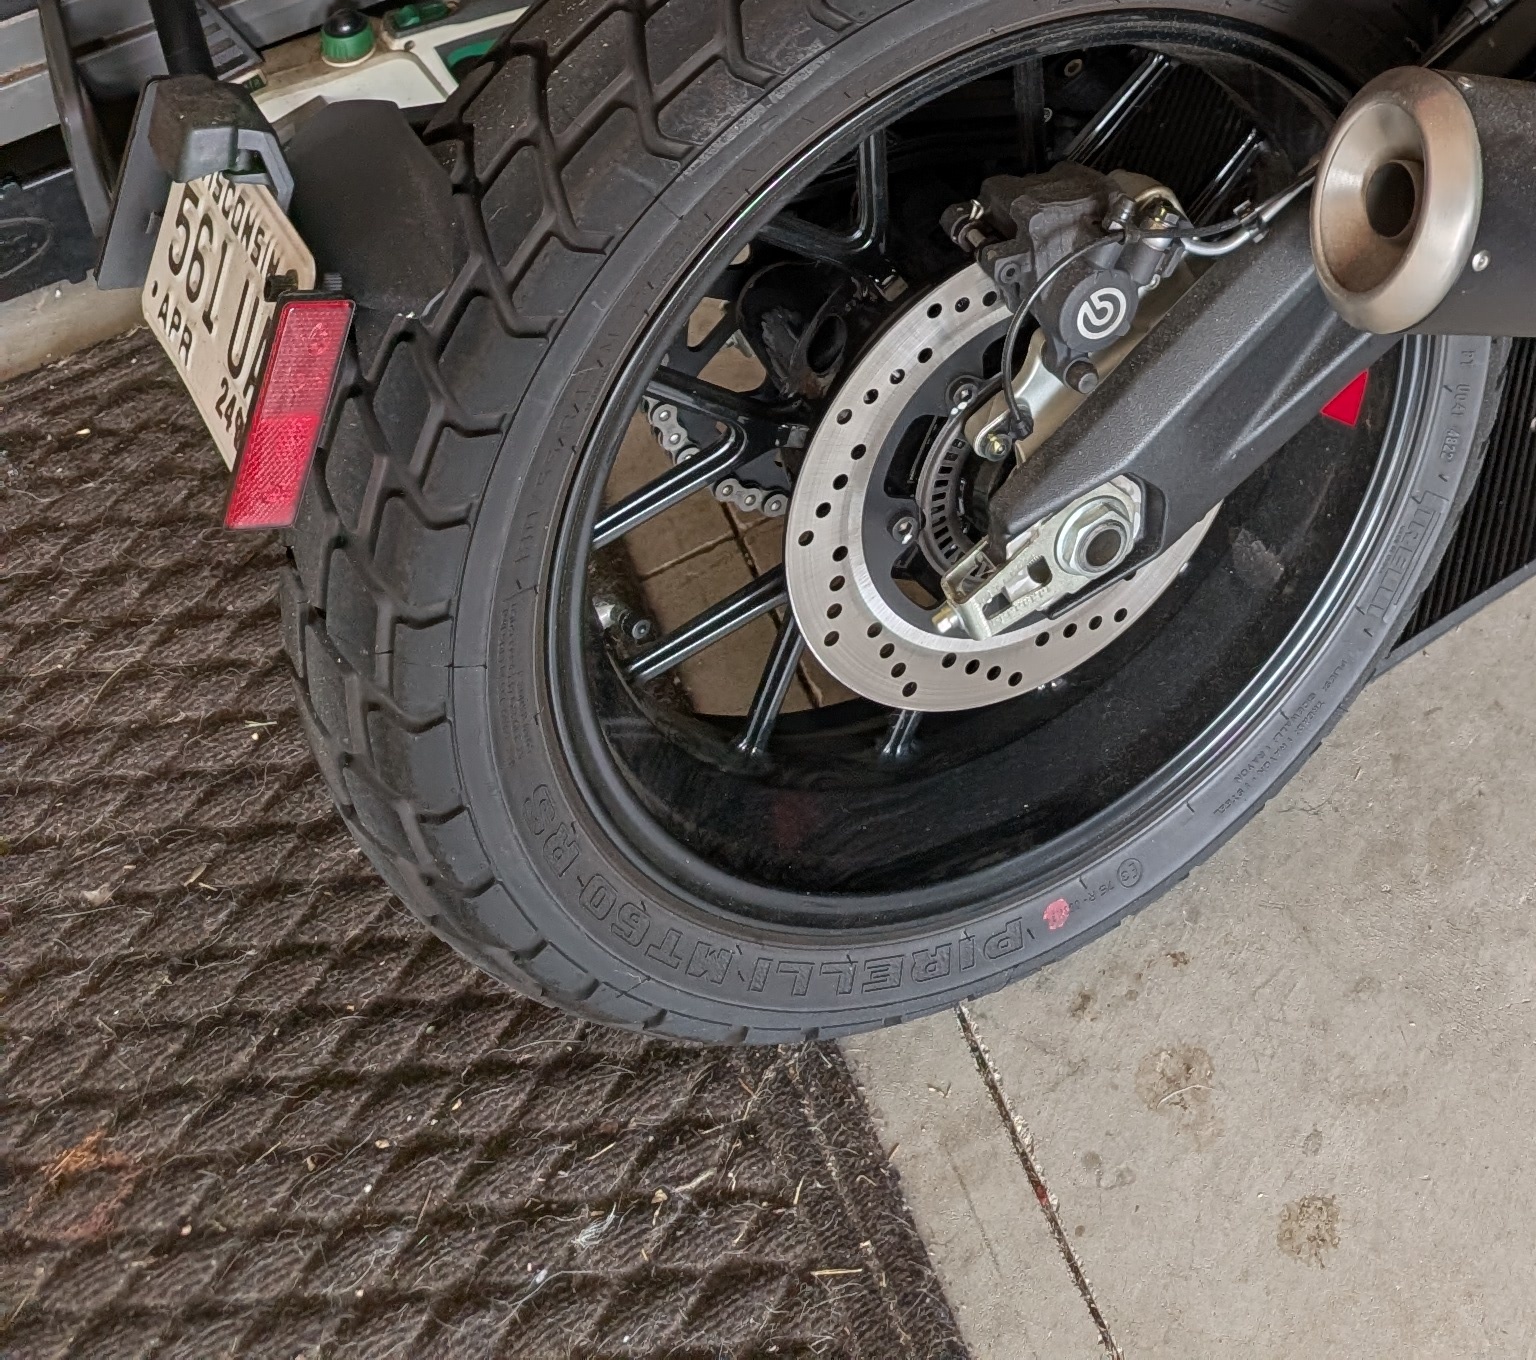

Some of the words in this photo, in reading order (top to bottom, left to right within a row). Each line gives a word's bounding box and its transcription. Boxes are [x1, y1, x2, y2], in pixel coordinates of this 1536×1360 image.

[168, 183, 228, 336] 561
[157, 287, 194, 363] APR
[751, 916, 1026, 997] PIRELLI
